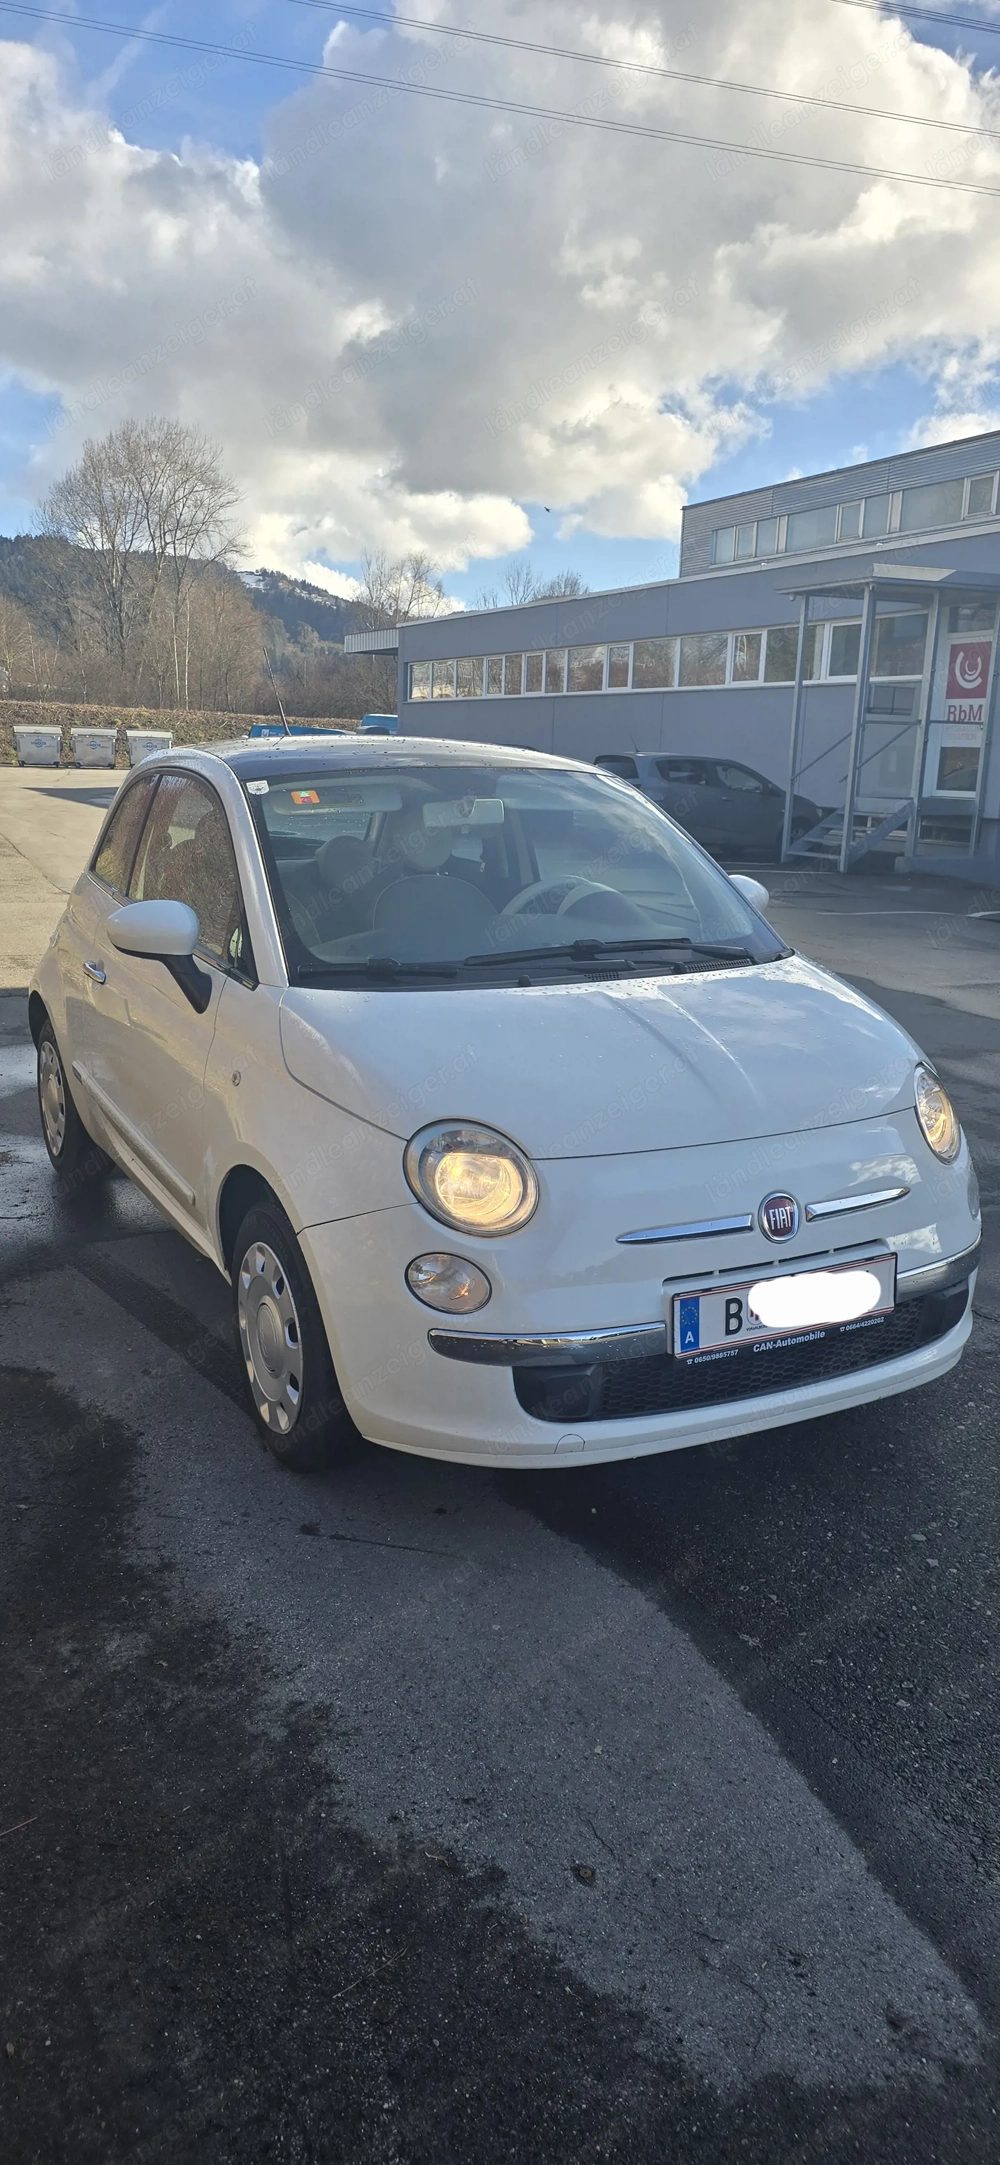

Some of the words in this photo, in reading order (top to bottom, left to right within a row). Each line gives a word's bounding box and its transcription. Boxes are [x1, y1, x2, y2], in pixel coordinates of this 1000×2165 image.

[947, 704, 983, 722] RbM
[769, 1206, 791, 1230] FIAT
[725, 1297, 743, 1337] B
[684, 1331, 695, 1344] A
[753, 1331, 826, 1353] CAN-Automobile
